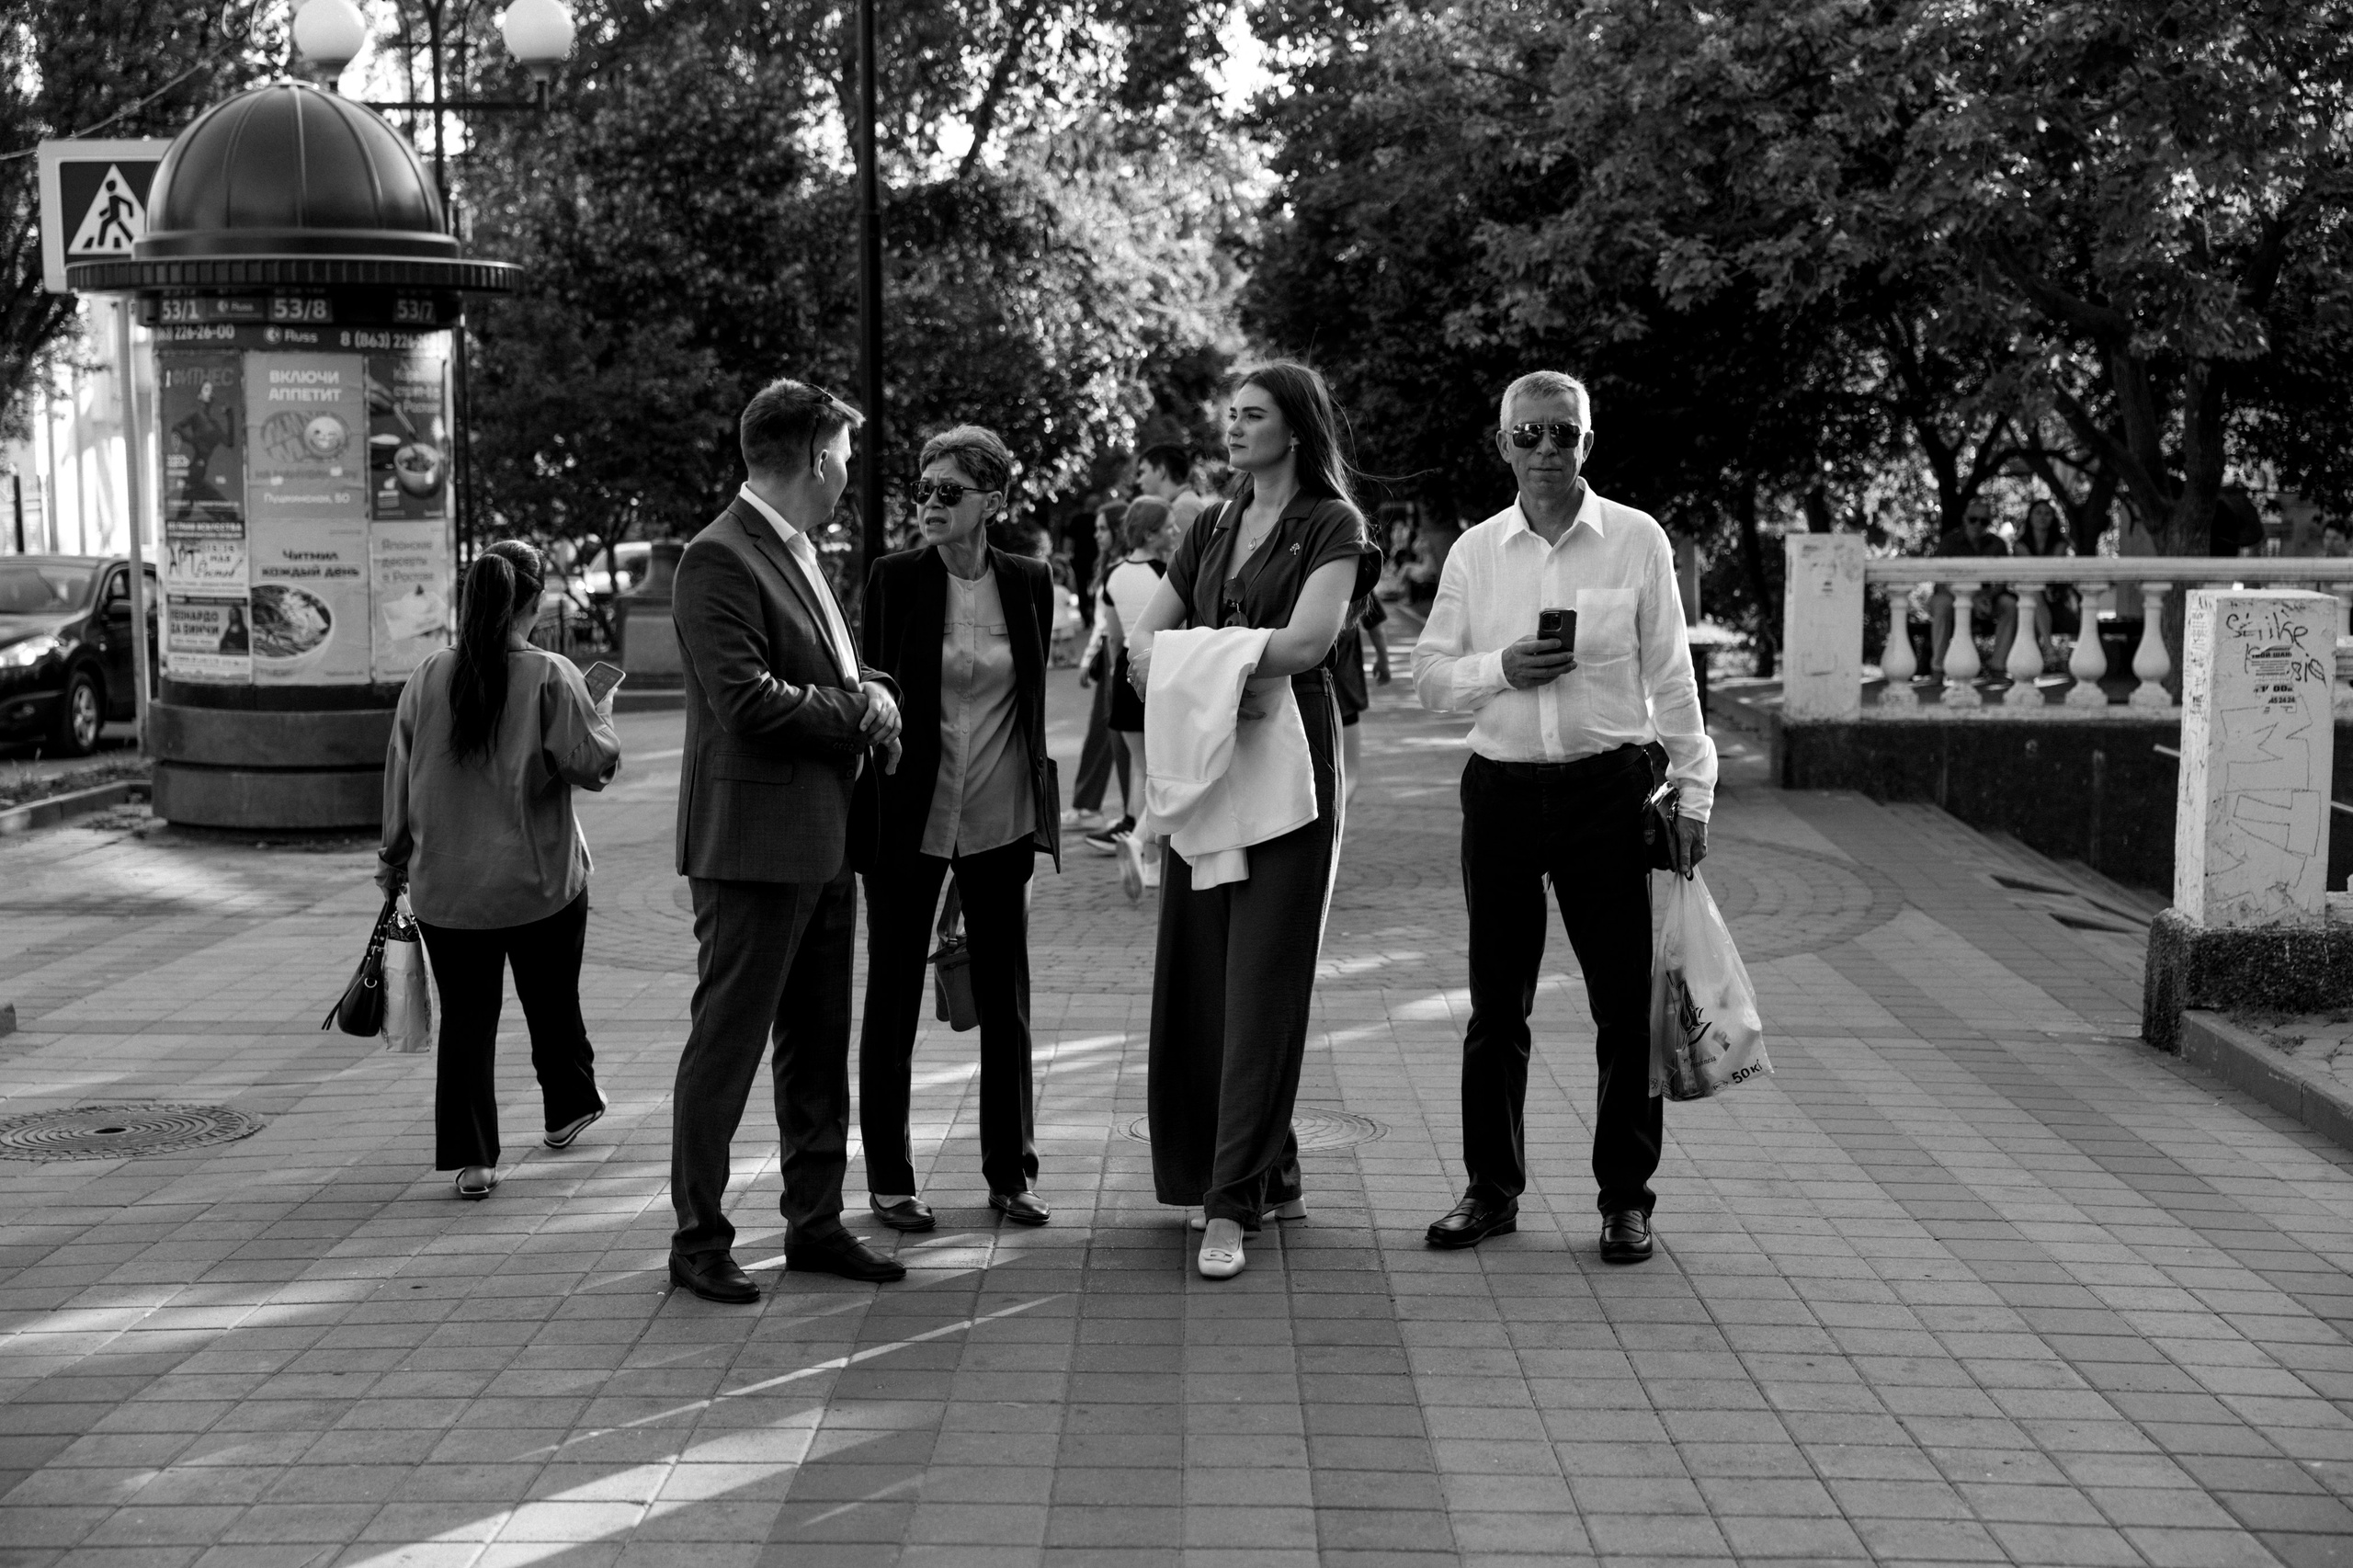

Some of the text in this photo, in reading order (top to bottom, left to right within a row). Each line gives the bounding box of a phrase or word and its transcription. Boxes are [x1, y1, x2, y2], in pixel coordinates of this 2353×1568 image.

[162, 300, 199, 322] 53/1
[274, 298, 326, 321] 53/8
[397, 299, 434, 321] 53/7
[175, 324, 235, 340] 226-26-00
[340, 331, 351, 347] 8
[355, 330, 391, 349] (863)
[269, 369, 340, 384] ВКЛЮЧИ
[268, 387, 342, 402] АППЕТИТ
[324, 567, 360, 579] день
[1732, 1068, 1751, 1084] 50
